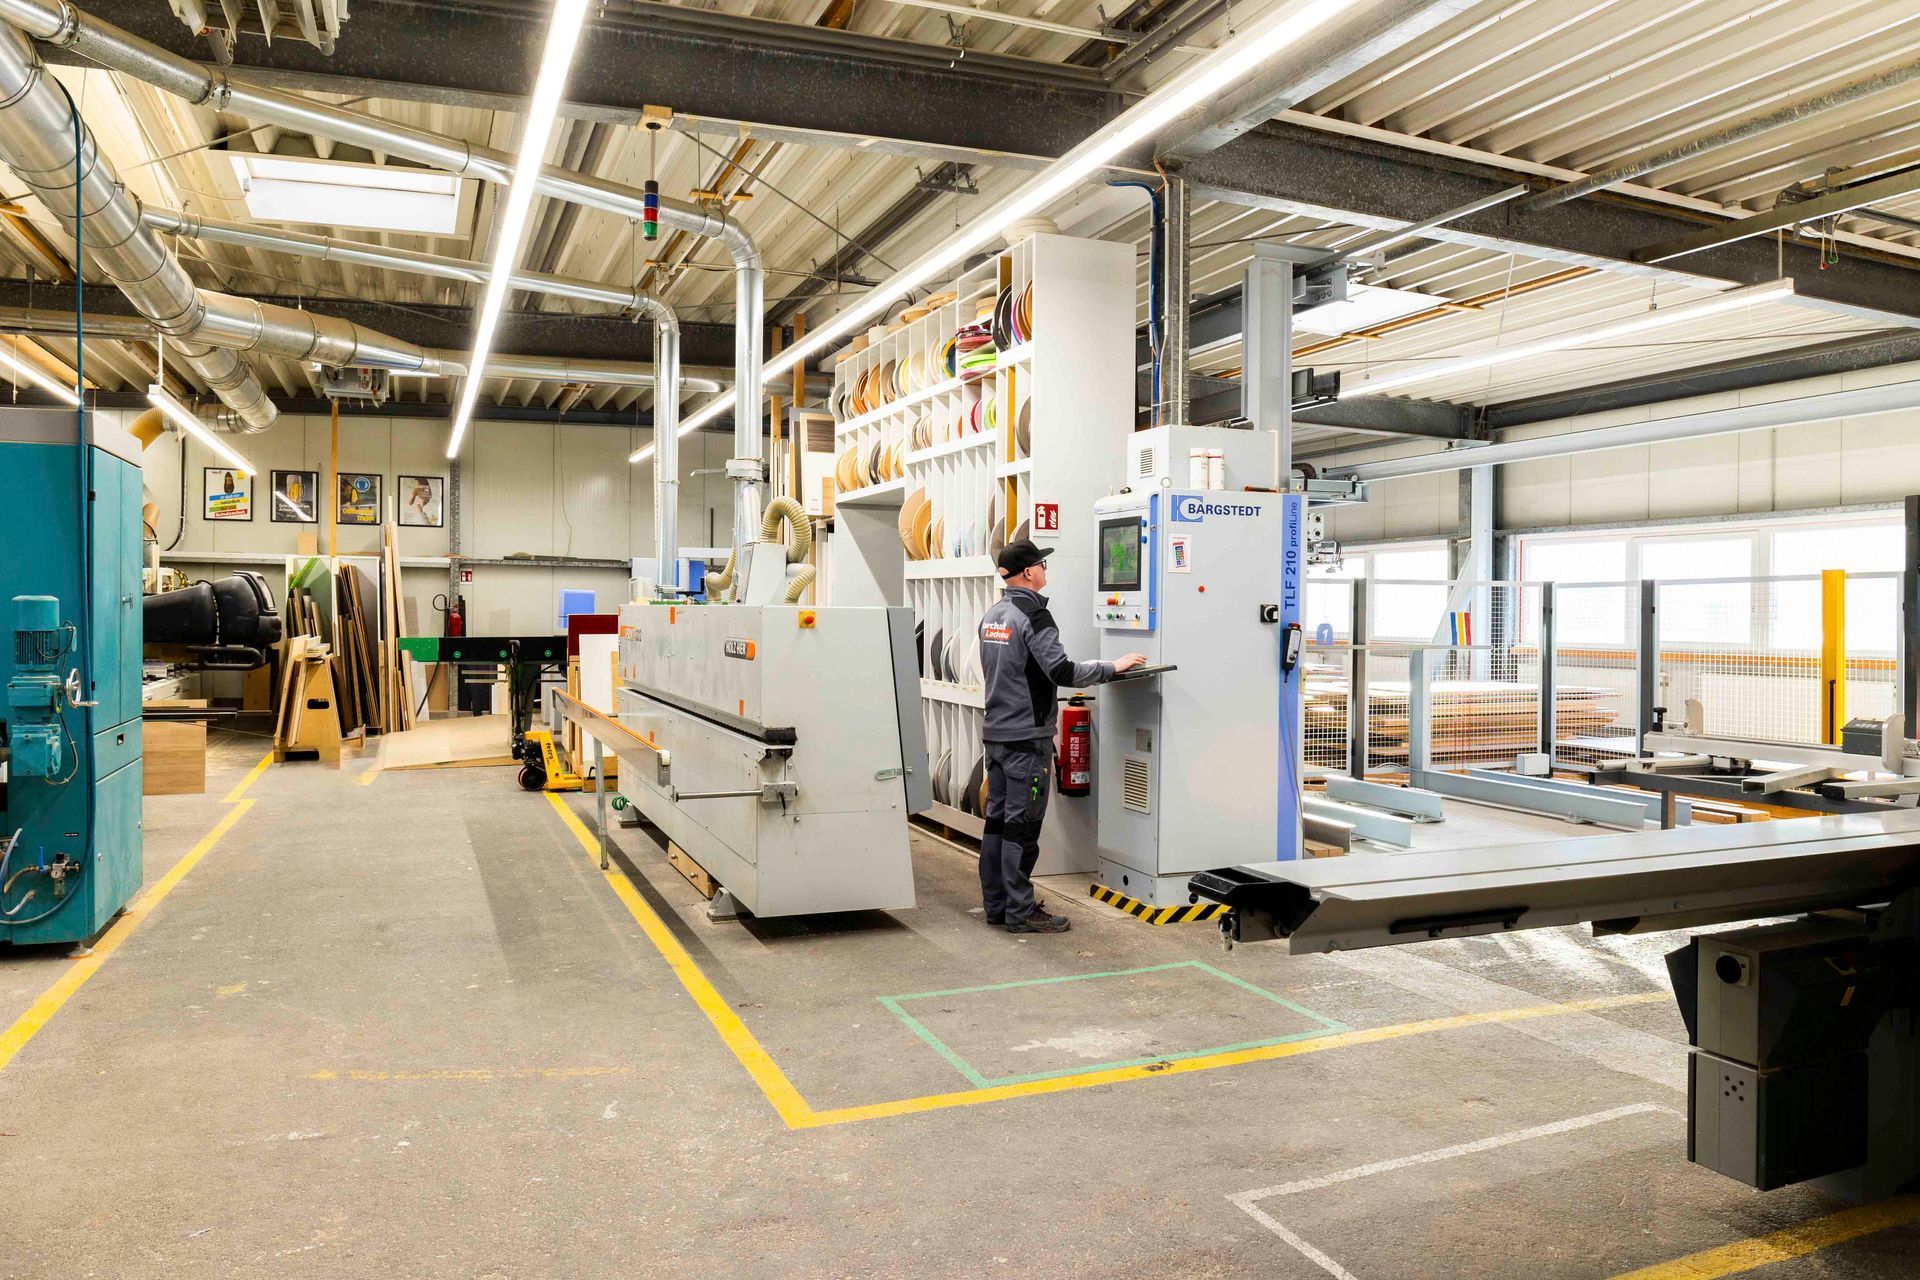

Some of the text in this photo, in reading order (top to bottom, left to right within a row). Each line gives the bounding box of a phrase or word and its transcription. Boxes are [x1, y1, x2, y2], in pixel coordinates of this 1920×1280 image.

[1188, 503, 1262, 517] BARGSTEDT
[1285, 502, 1298, 610] TLF 210 profiLine
[1322, 629, 1329, 642] 1
